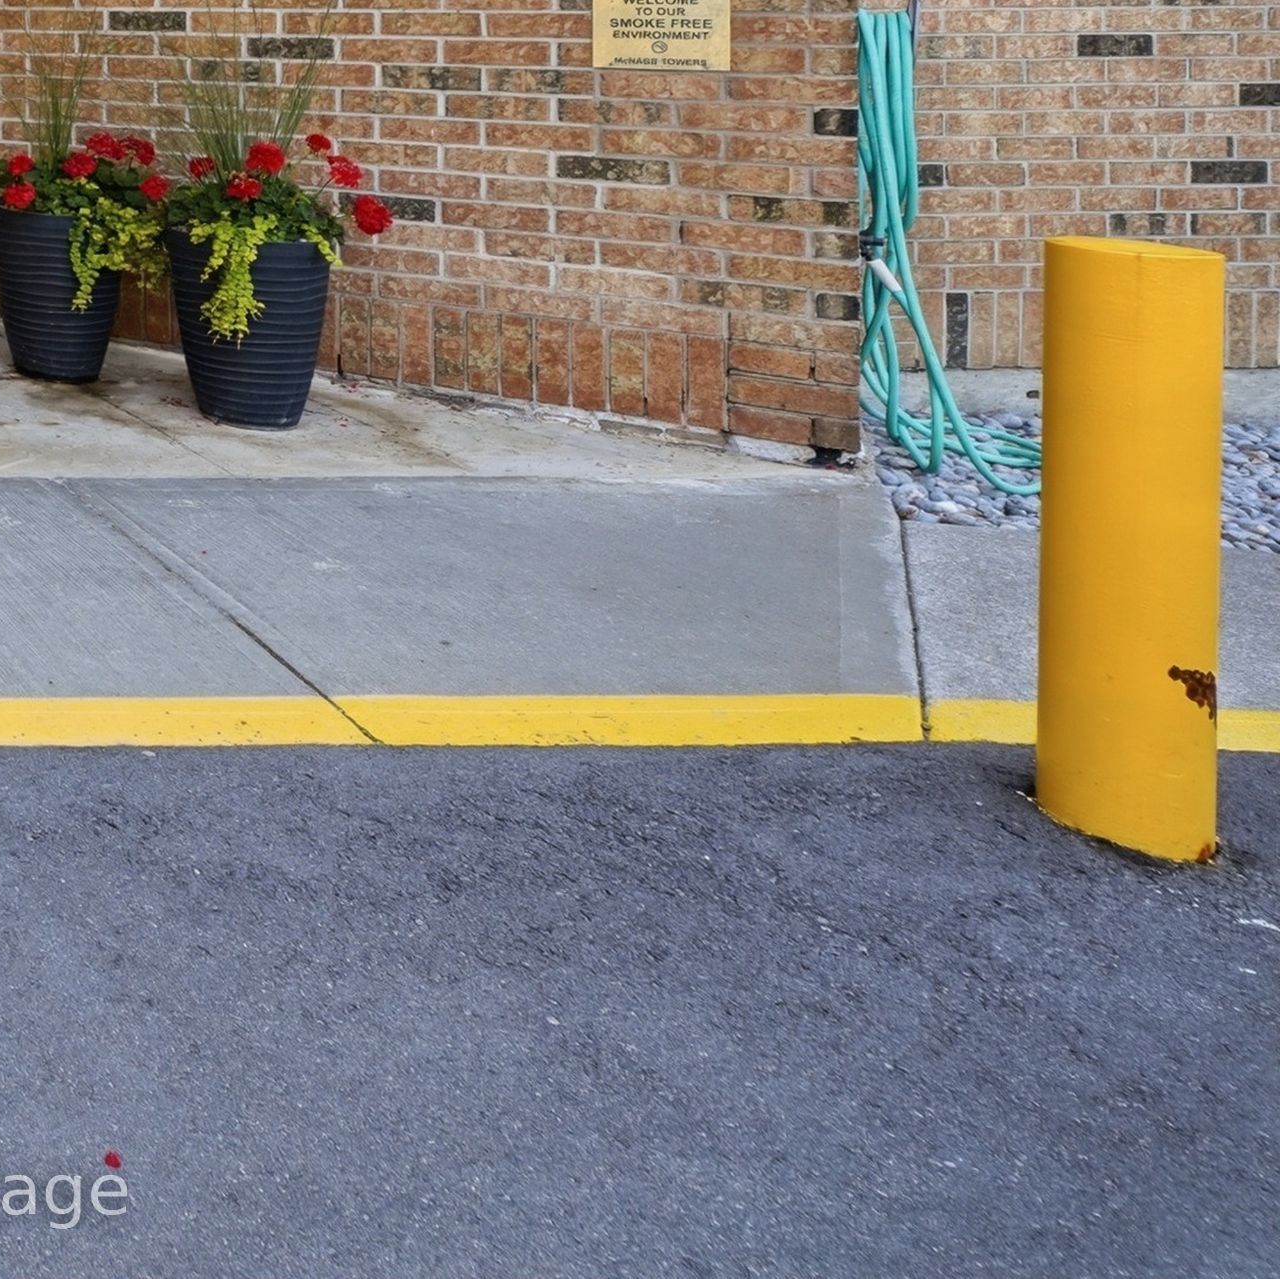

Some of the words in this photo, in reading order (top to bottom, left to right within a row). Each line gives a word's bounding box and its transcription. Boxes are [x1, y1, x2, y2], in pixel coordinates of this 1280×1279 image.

[635, 7, 653, 16] TO
[656, 7, 686, 16] OUR
[609, 18, 665, 28] SMOKE
[670, 19, 713, 29] FREE
[612, 30, 711, 40] ENVIRONMENT
